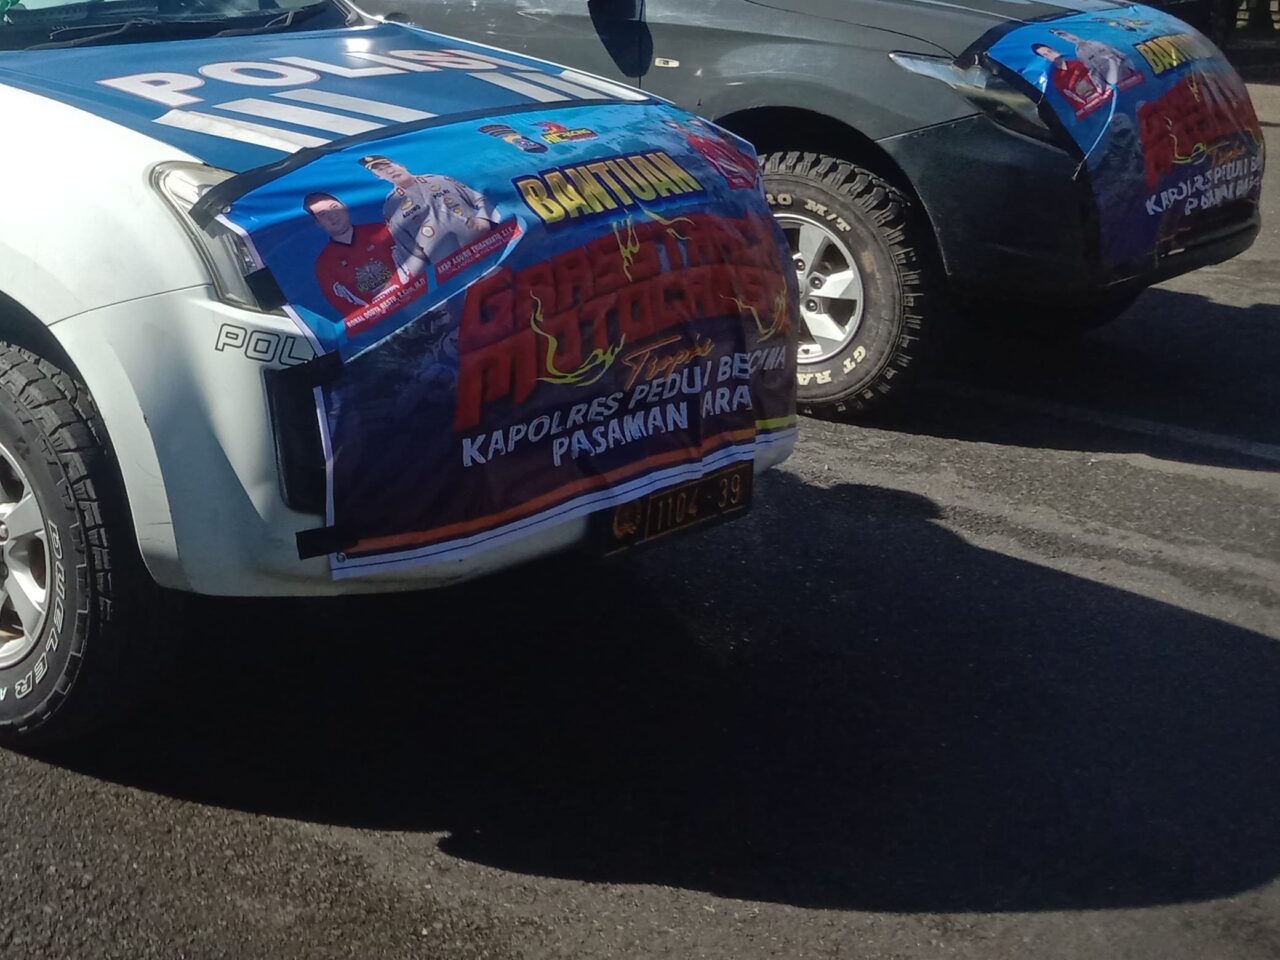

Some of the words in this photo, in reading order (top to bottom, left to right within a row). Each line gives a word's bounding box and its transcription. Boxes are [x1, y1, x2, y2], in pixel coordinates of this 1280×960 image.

[95, 48, 542, 108] POLISI
[517, 150, 705, 223] BANTUAN
[804, 197, 851, 233] M/T
[462, 390, 624, 468] KAPOLRES
[552, 401, 689, 468] PASAMAN
[13, 519, 68, 700] DUELER
